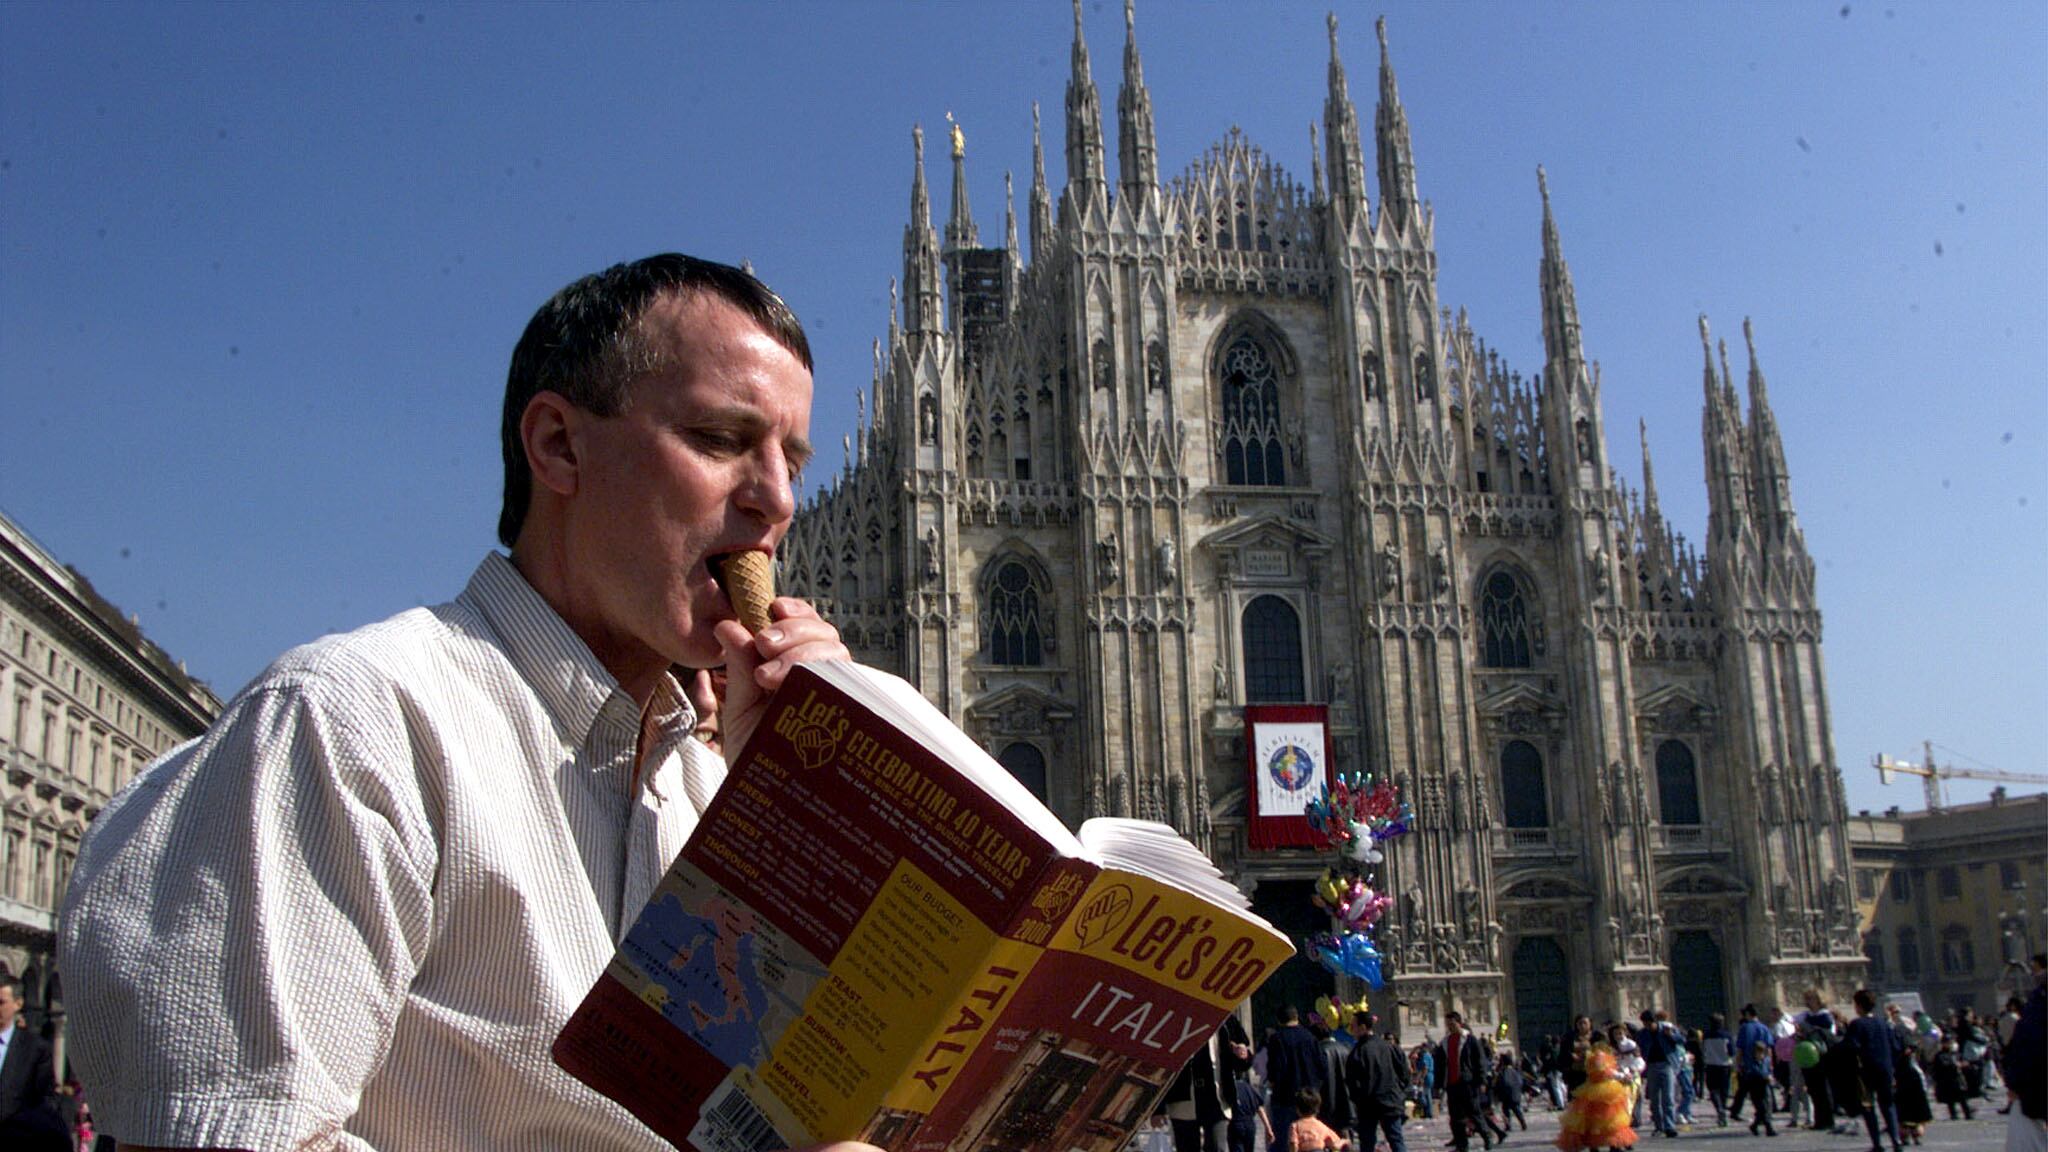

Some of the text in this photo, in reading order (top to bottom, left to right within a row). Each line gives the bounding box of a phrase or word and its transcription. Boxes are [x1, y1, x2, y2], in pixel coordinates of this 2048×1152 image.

[798, 689, 850, 741] Let's
[753, 751, 790, 781] SAVVY
[735, 779, 773, 808] FRESH
[846, 728, 1032, 880] CELEBRATING 40 YEARS
[718, 807, 762, 841] HONEST
[874, 777, 902, 801] BIBLE
[900, 796, 915, 811] OF
[915, 807, 934, 825] THE
[934, 821, 969, 852] BUDGET
[970, 850, 1016, 890] TRAVELER
[701, 834, 760, 879] THOROUGH
[900, 873, 922, 894] OUR
[1050, 869, 1084, 897] Let's
[1111, 894, 1267, 1001] Let's Go
[832, 976, 862, 1002] FEAST
[805, 1015, 846, 1054] BURROW
[912, 965, 1019, 1093] ITALY
[1071, 981, 1210, 1054] ITALY
[773, 1061, 810, 1098] MARVEL
